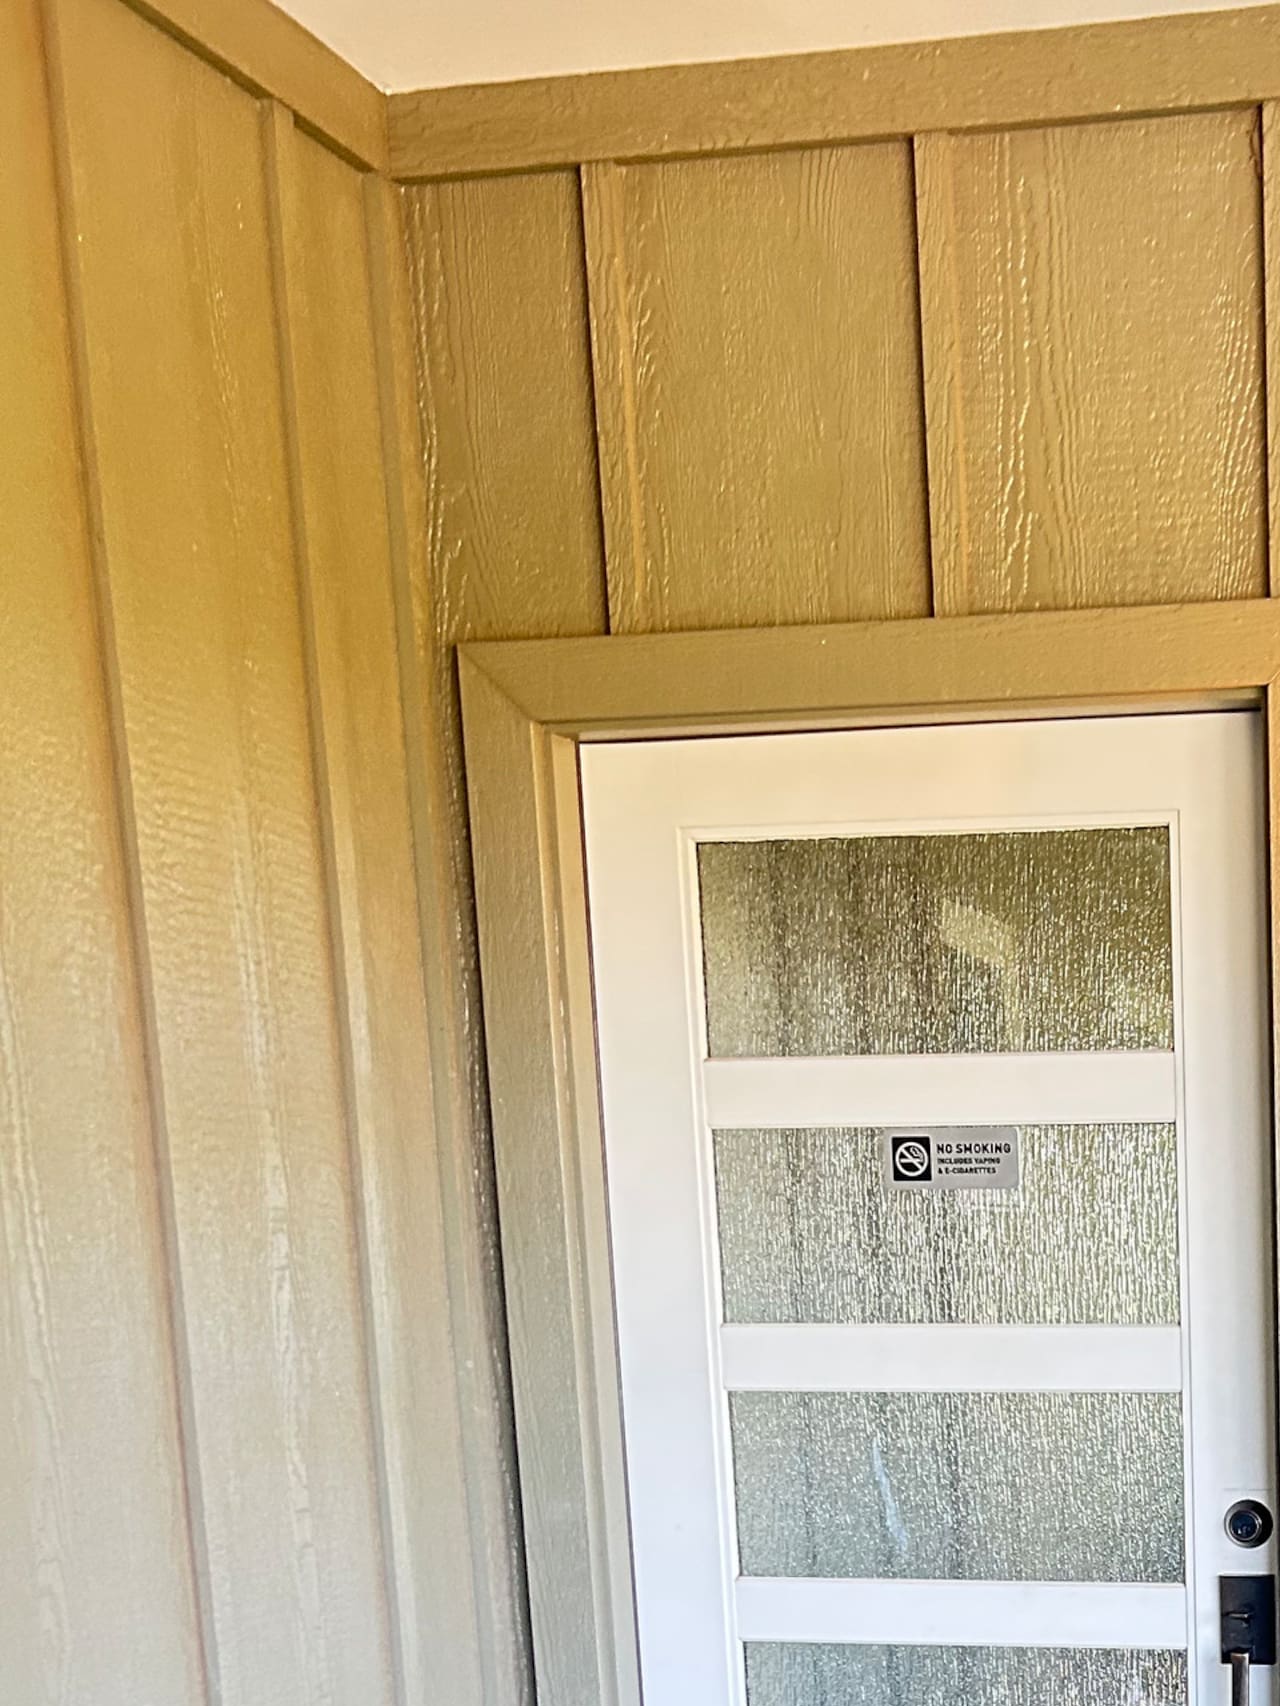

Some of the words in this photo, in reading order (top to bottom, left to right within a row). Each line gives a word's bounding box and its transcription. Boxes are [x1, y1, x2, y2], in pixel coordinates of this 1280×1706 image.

[936, 1143, 953, 1154] NO
[956, 1143, 1011, 1154] SMOKING
[937, 1157, 973, 1165] INCLUDES
[974, 1157, 1001, 1165] VAPING
[945, 1166, 997, 1174] E-CIGARETTES
